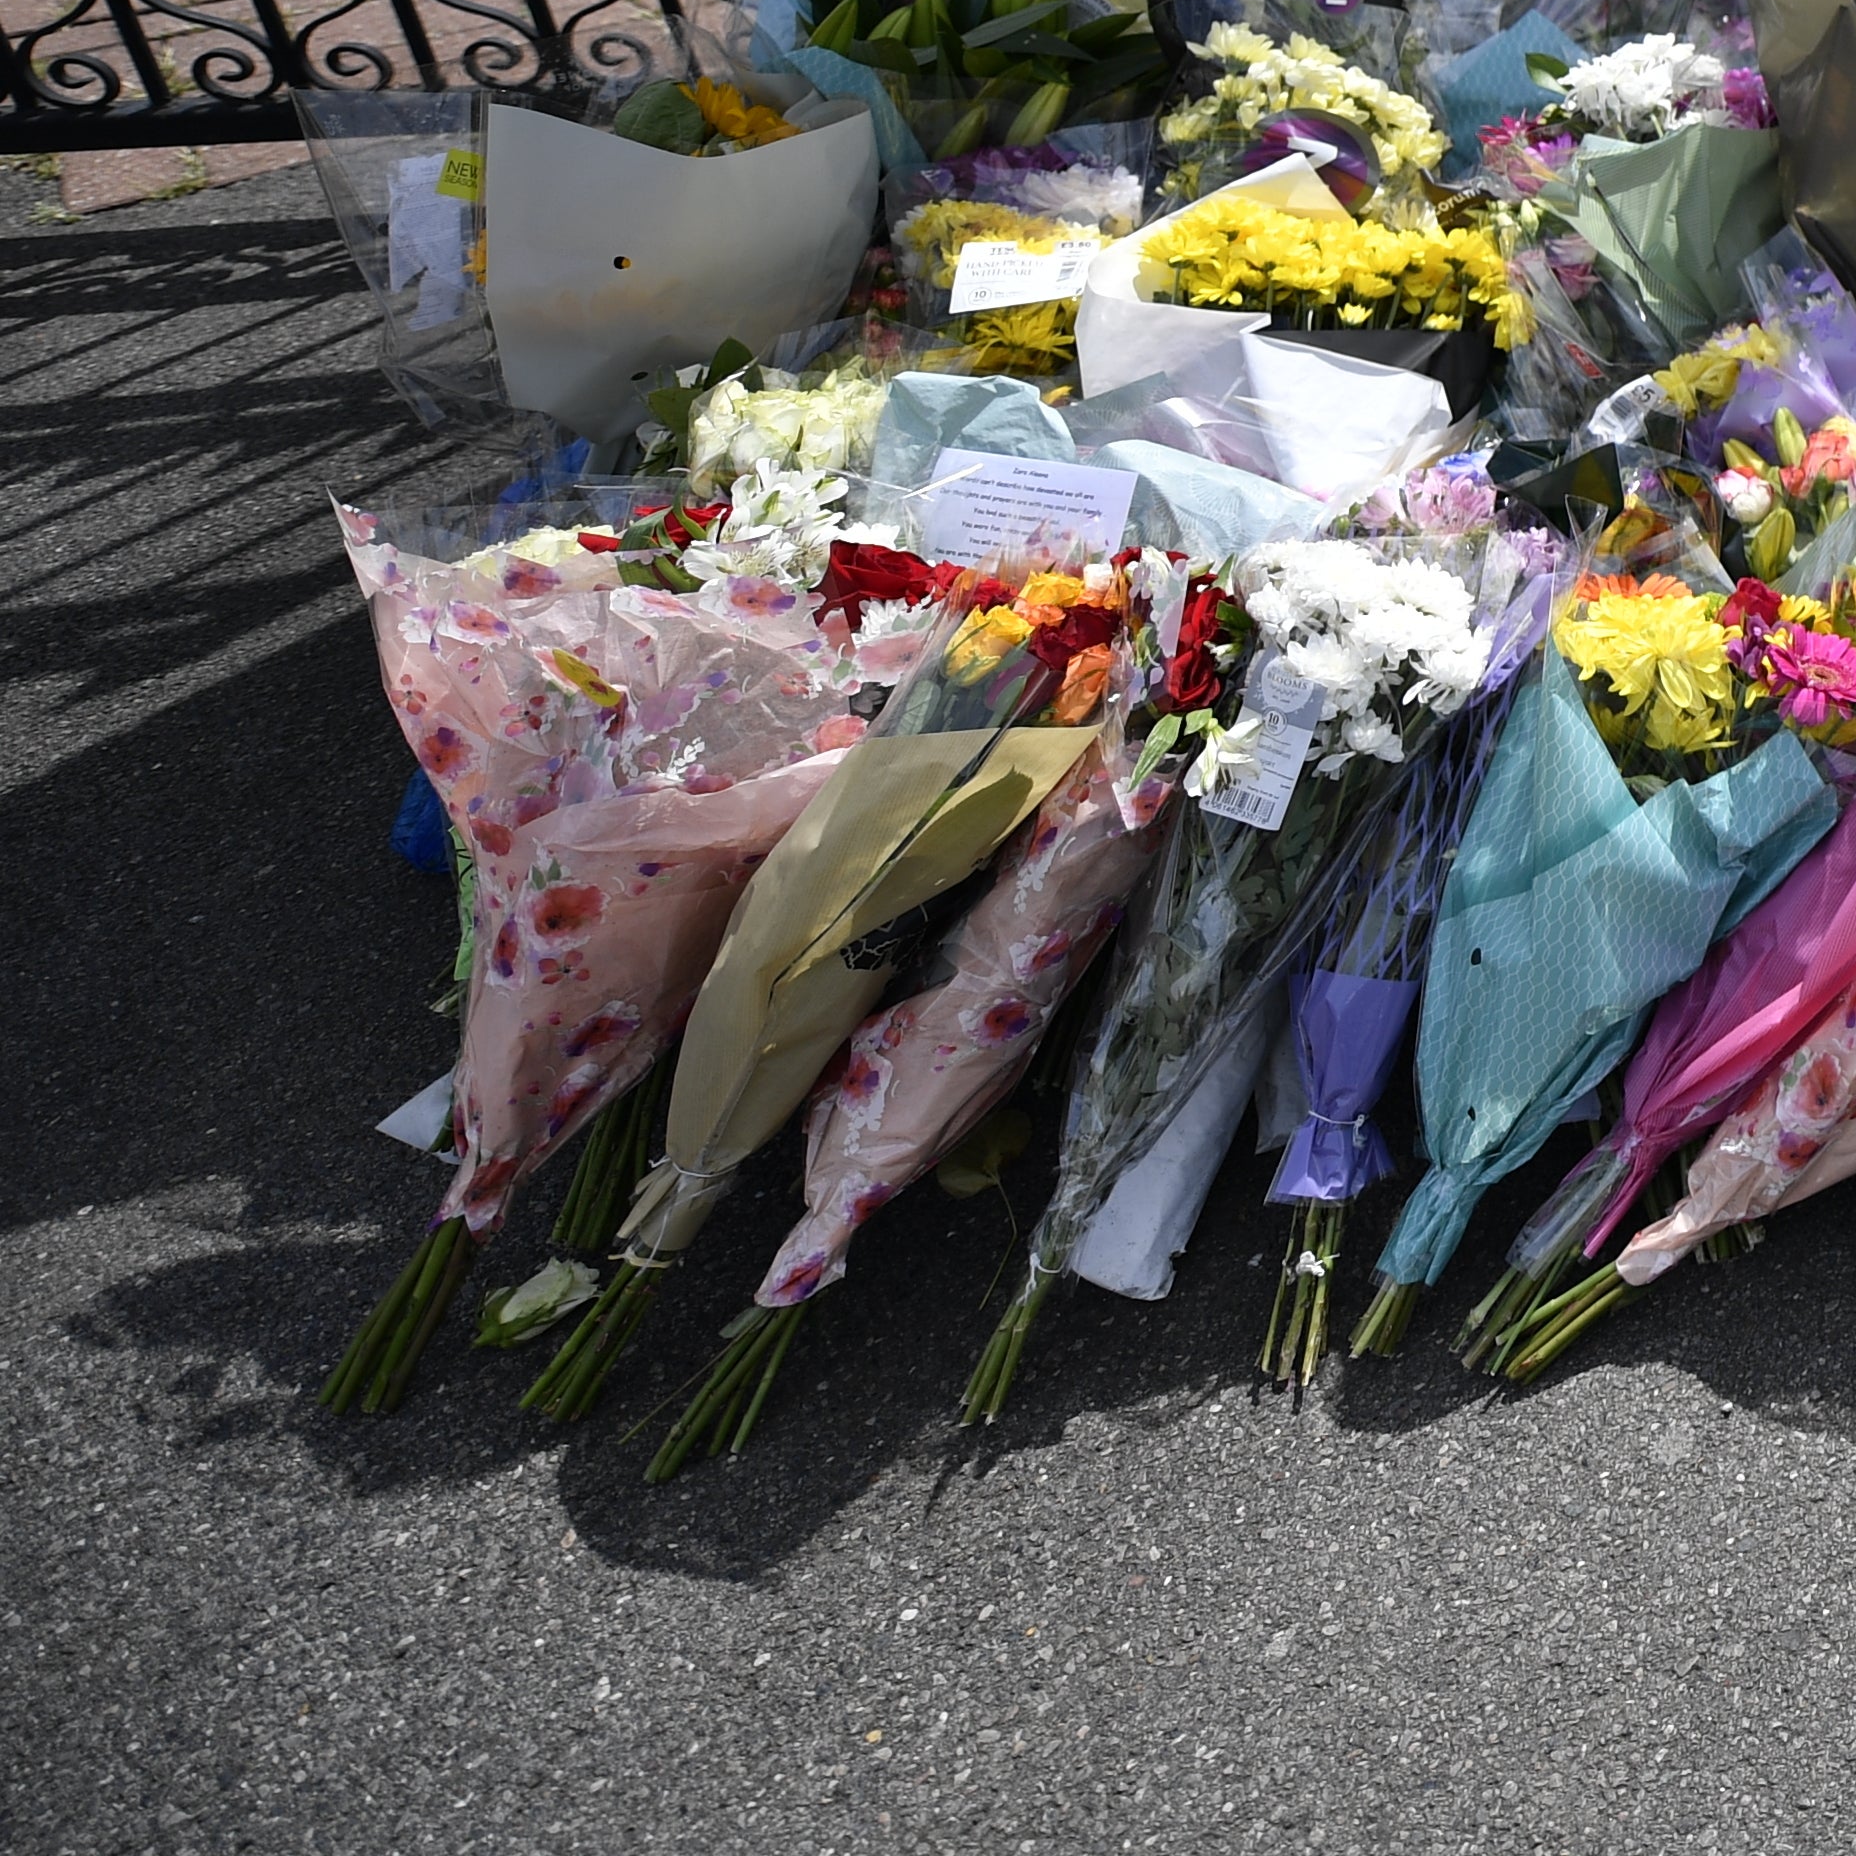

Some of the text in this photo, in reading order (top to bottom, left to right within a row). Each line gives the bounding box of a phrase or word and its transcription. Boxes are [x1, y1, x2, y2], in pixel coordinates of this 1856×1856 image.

[446, 160, 480, 180] NEW
[974, 290, 987, 299] 10
[1266, 671, 1309, 691] BLOOMS
[1268, 712, 1279, 725] 10
